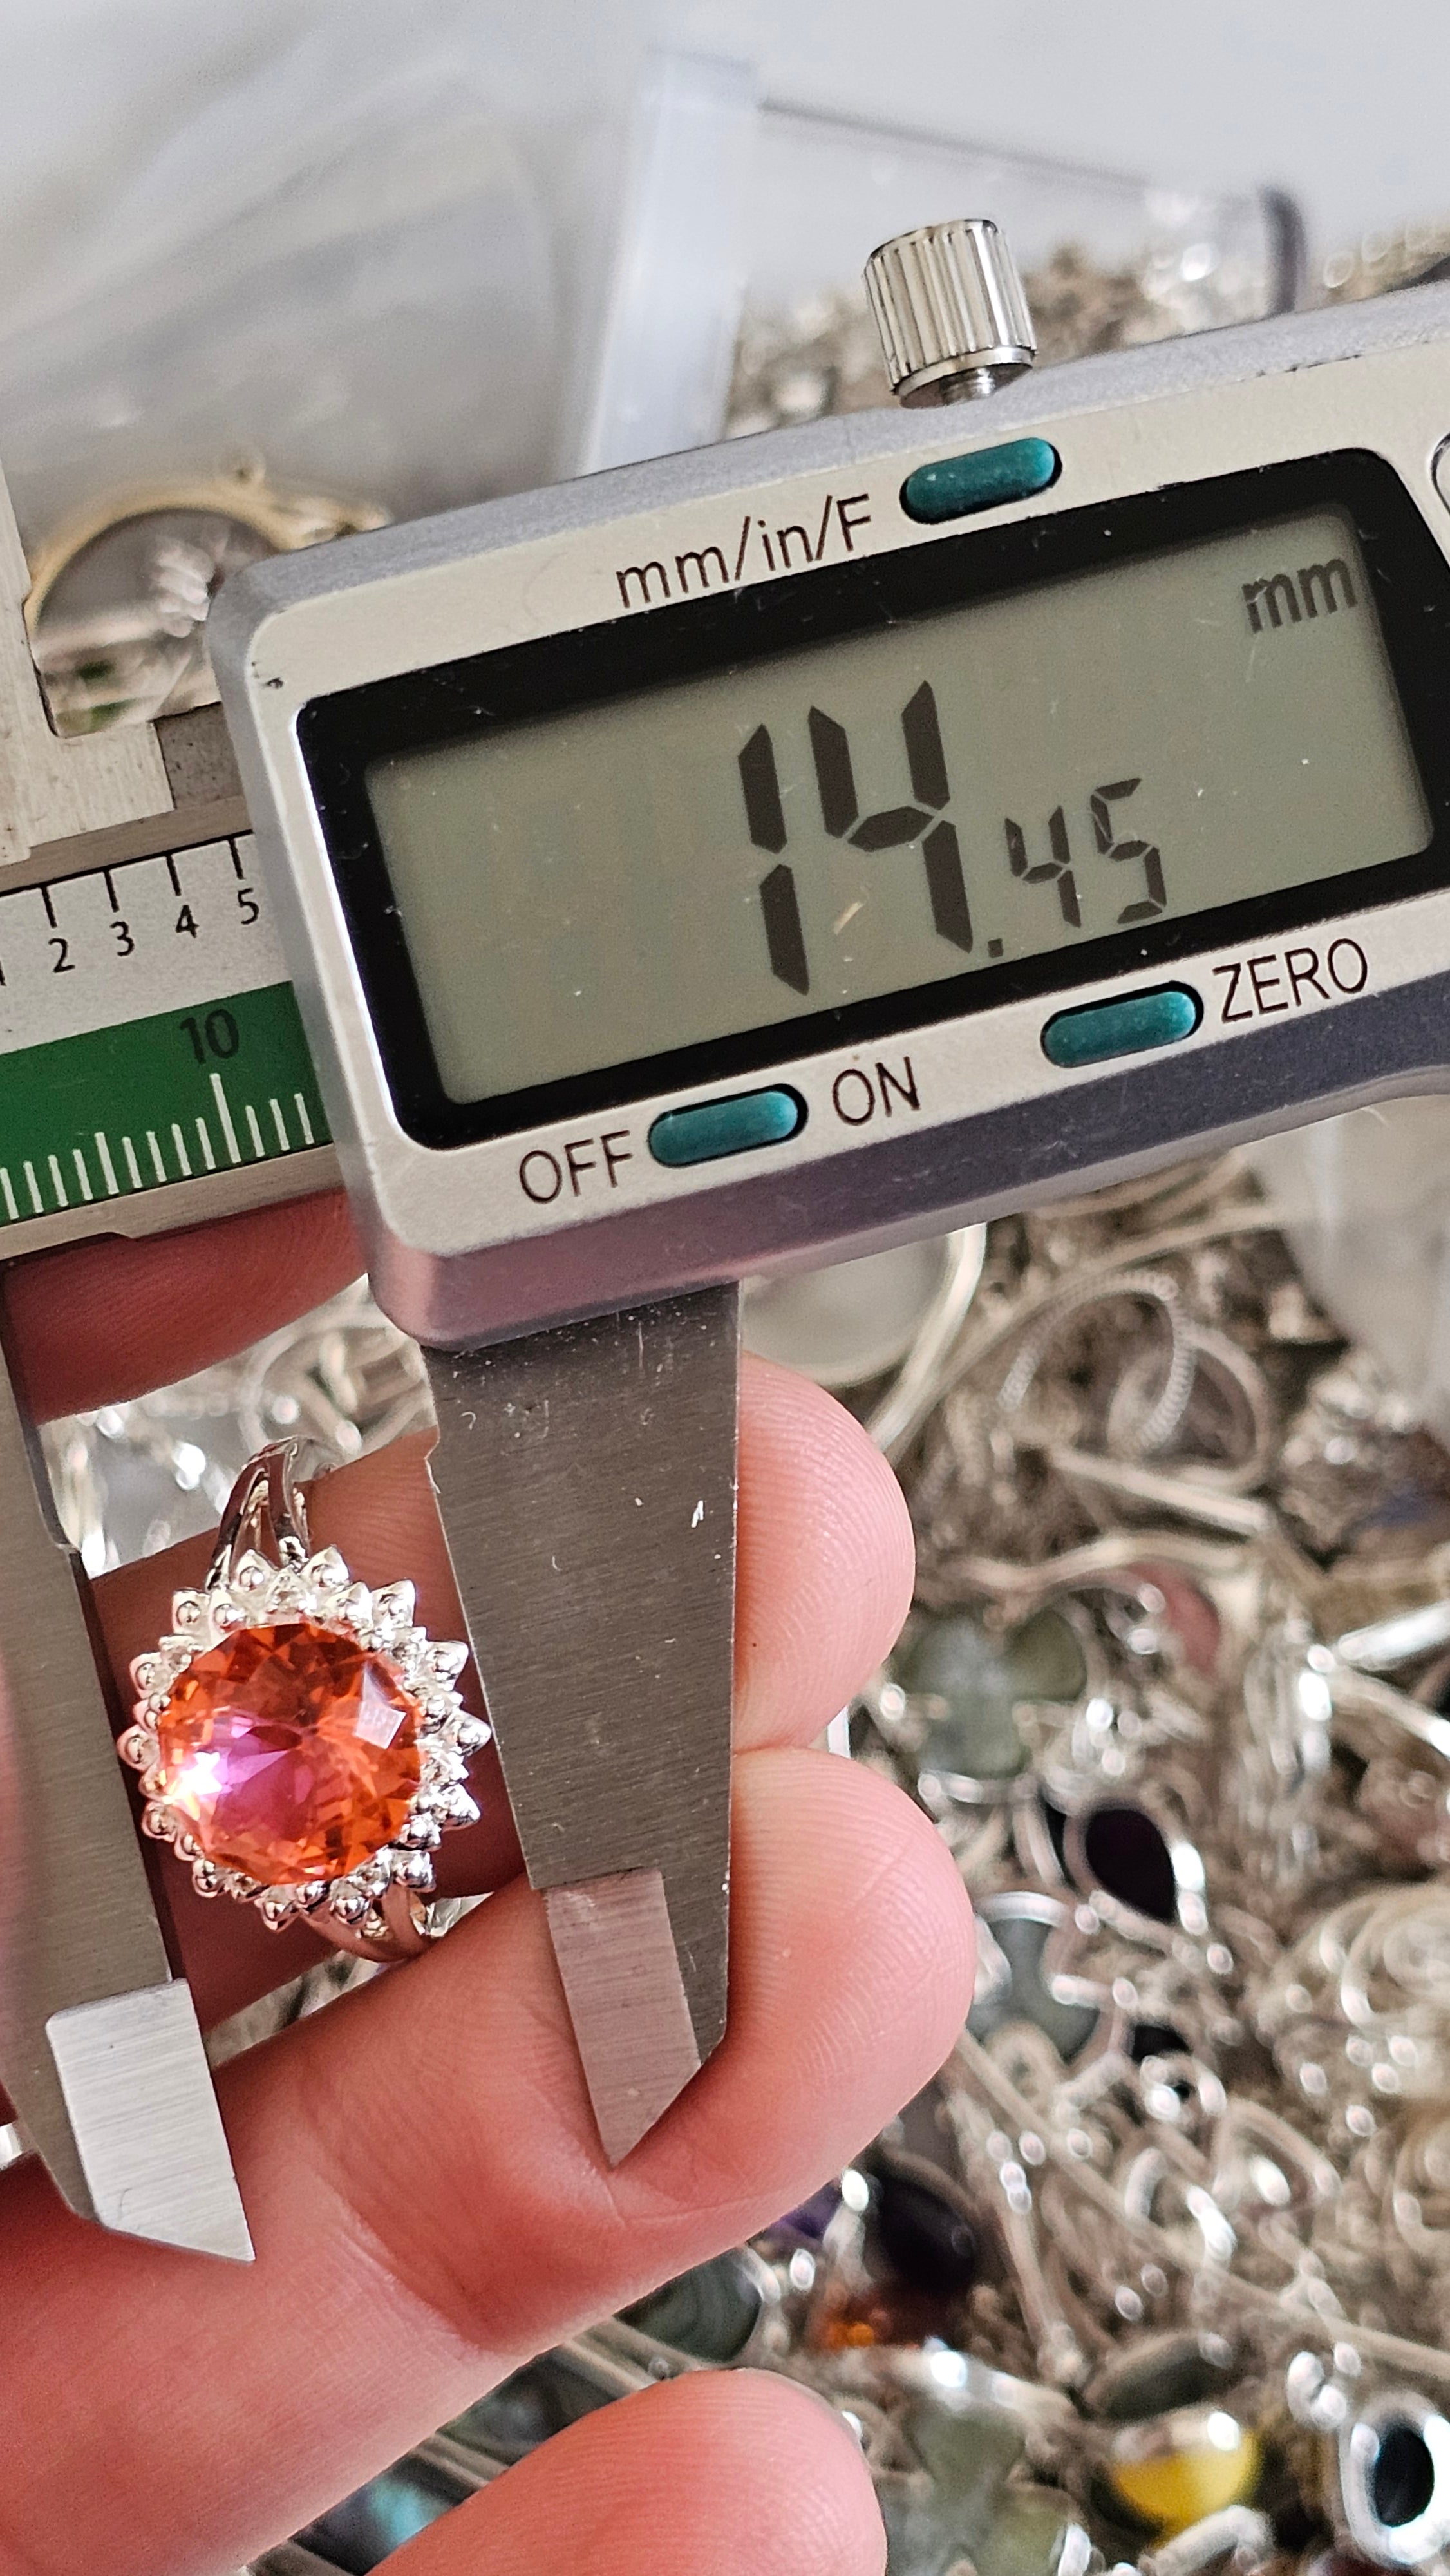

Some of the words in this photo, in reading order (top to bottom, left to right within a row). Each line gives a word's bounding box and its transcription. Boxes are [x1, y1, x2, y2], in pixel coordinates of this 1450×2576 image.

[616, 494, 871, 609] mm/in/F
[1241, 558, 1358, 634] mm
[738, 680, 1167, 996] 14.45
[48, 938, 75, 973] 2
[110, 921, 135, 956] 3
[175, 904, 199, 938] 4
[236, 888, 259, 925] 5
[1212, 938, 1368, 1023] ZERO
[180, 1008, 240, 1065] 10
[832, 1056, 921, 1126] ON
[519, 1130, 633, 1204] OFF
